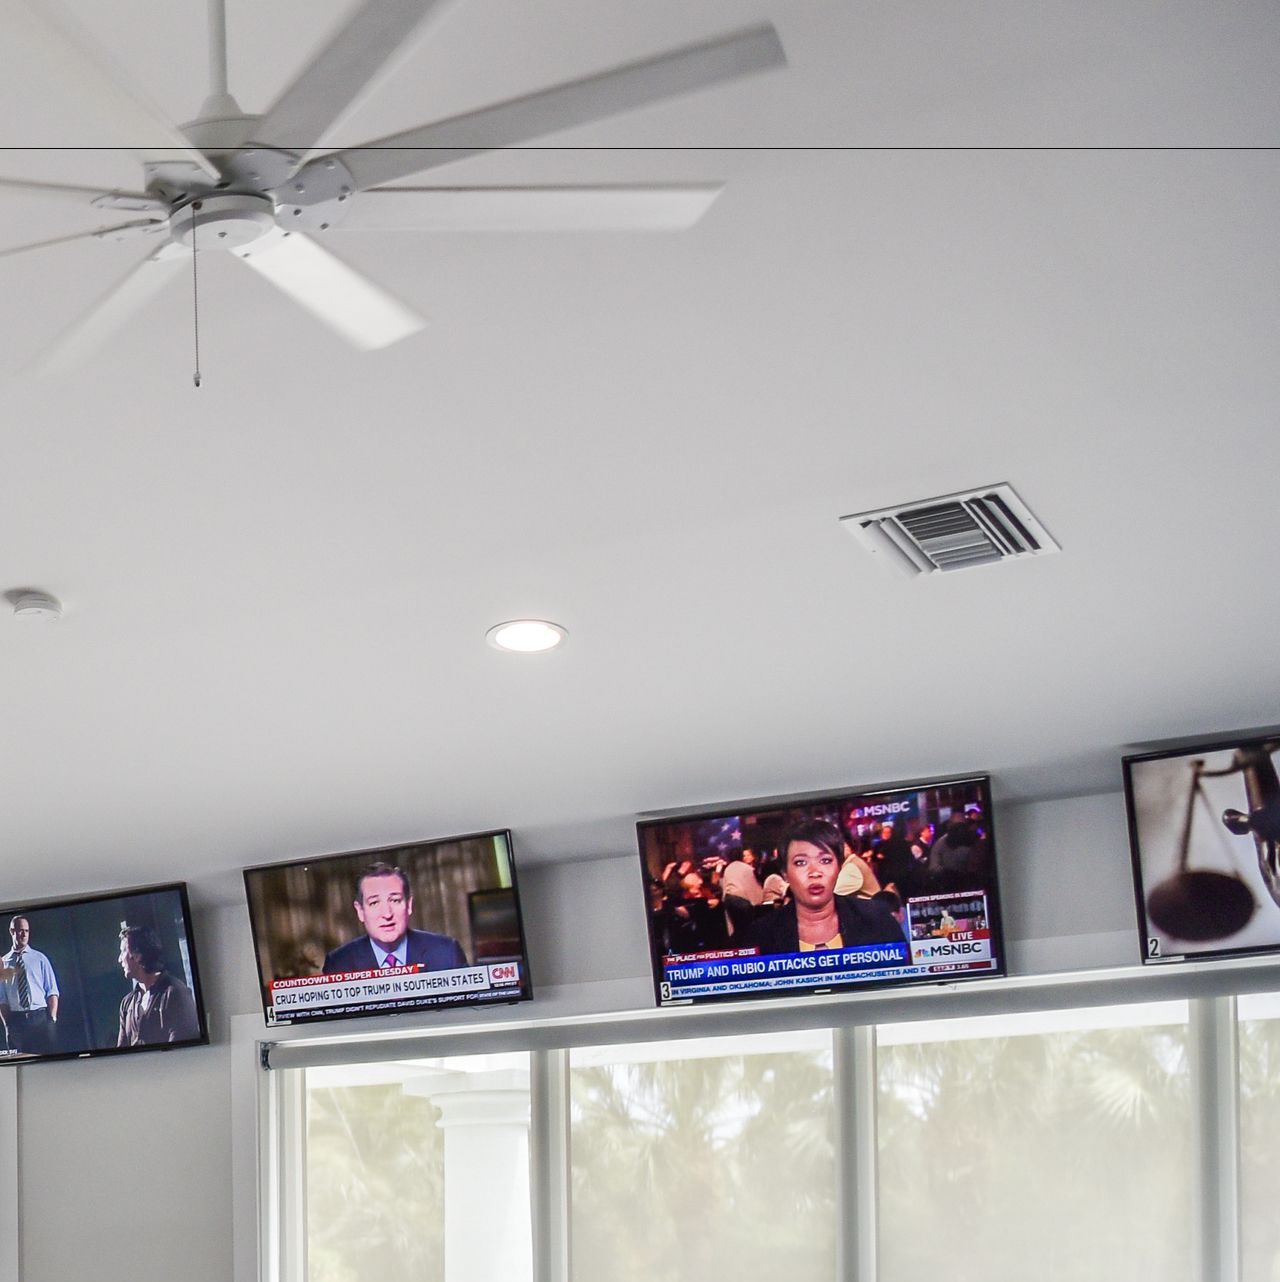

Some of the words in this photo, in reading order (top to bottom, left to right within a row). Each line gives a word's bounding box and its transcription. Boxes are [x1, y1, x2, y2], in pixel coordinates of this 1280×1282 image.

[864, 801, 910, 816] MSNBC
[952, 932, 973, 941] LIVE
[705, 950, 734, 959] POLITICS
[930, 942, 982, 957] MSNBC
[1149, 938, 1159, 957] 2
[492, 966, 515, 979] CNN
[667, 967, 704, 981] TRUMP
[707, 964, 729, 978] AND
[732, 961, 765, 976] RUBIO
[767, 957, 816, 972] ATTACKS
[818, 954, 840, 967] GET
[843, 949, 903, 965] PERSONAL
[273, 976, 329, 989] COUNTDOWN
[330, 974, 342, 982] TO
[344, 971, 371, 981] SUPER
[373, 965, 414, 977] TUESDAY
[680, 986, 710, 995] VIRGINIA
[795, 976, 823, 984] KASICH
[834, 969, 900, 980] MASSACHUSETTS
[275, 994, 296, 1005] CRUZ
[299, 990, 329, 1003] HOPING
[331, 988, 343, 999] TO
[344, 987, 361, 998] TOP
[363, 984, 391, 996] TRUMP
[393, 983, 401, 992] IN
[404, 977, 449, 991] SOUTHERN
[451, 973, 484, 986] STATES
[662, 983, 670, 999] 3
[268, 1007, 275, 1022] 4
